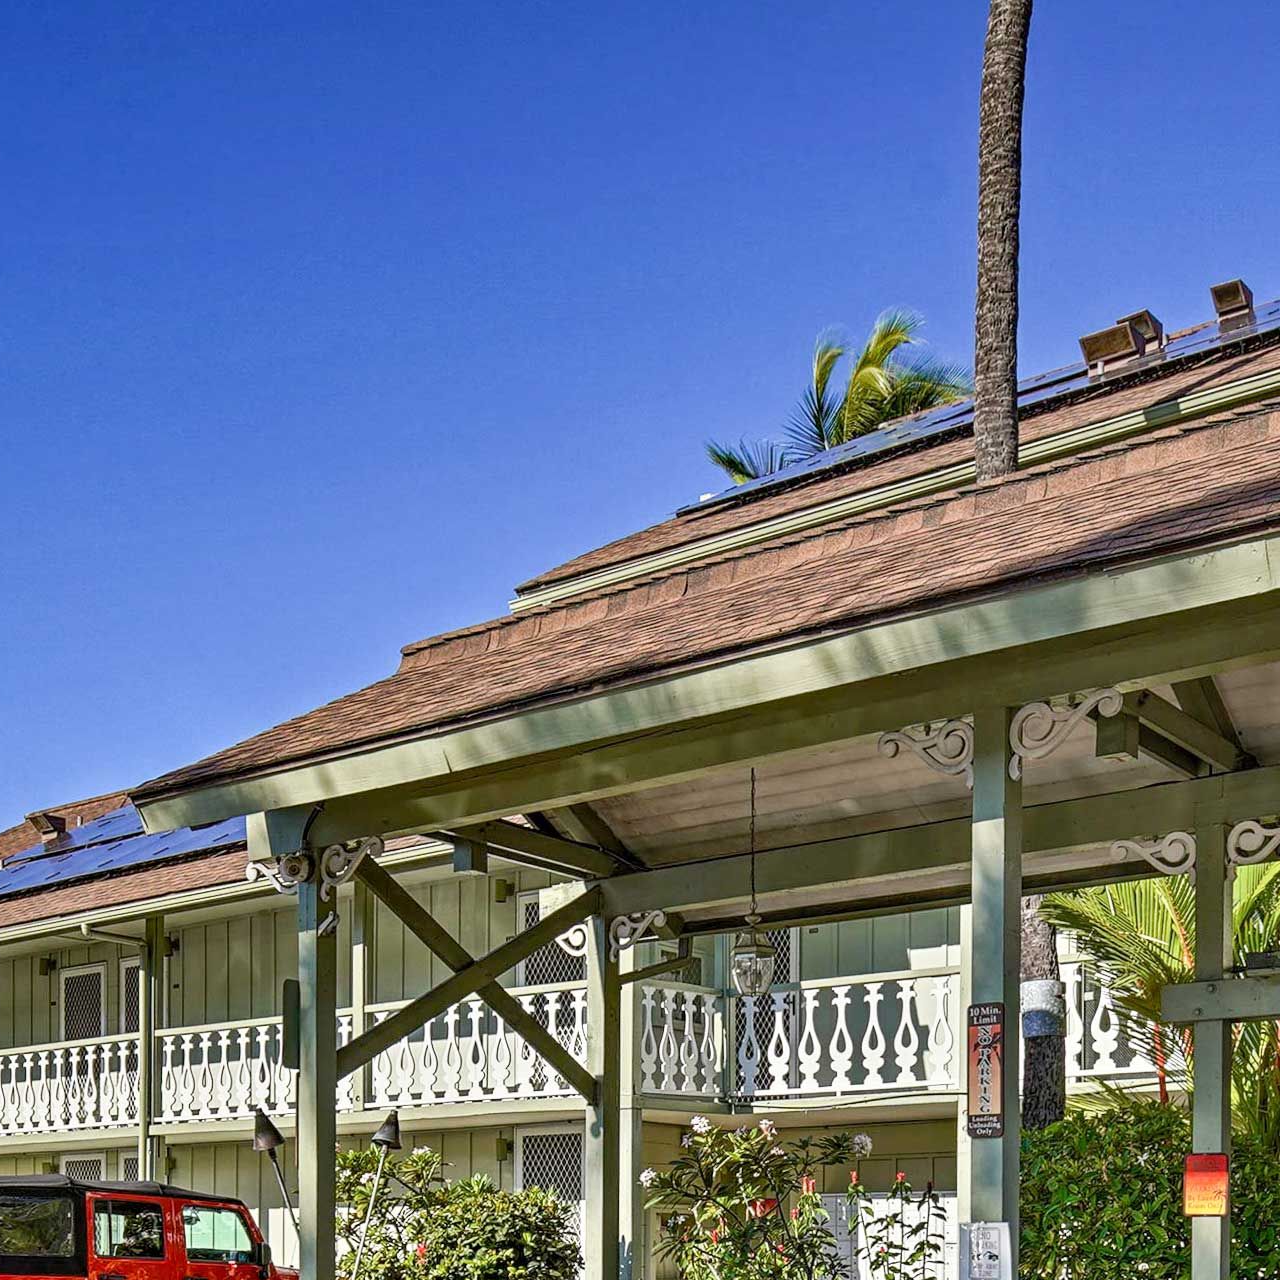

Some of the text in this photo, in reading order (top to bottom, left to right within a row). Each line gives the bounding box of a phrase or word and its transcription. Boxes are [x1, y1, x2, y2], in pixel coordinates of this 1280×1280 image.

[970, 1006, 1001, 1017] 10 Min.
[973, 1015, 997, 1025] Limit
[977, 1025, 992, 1112] NO PARKING
